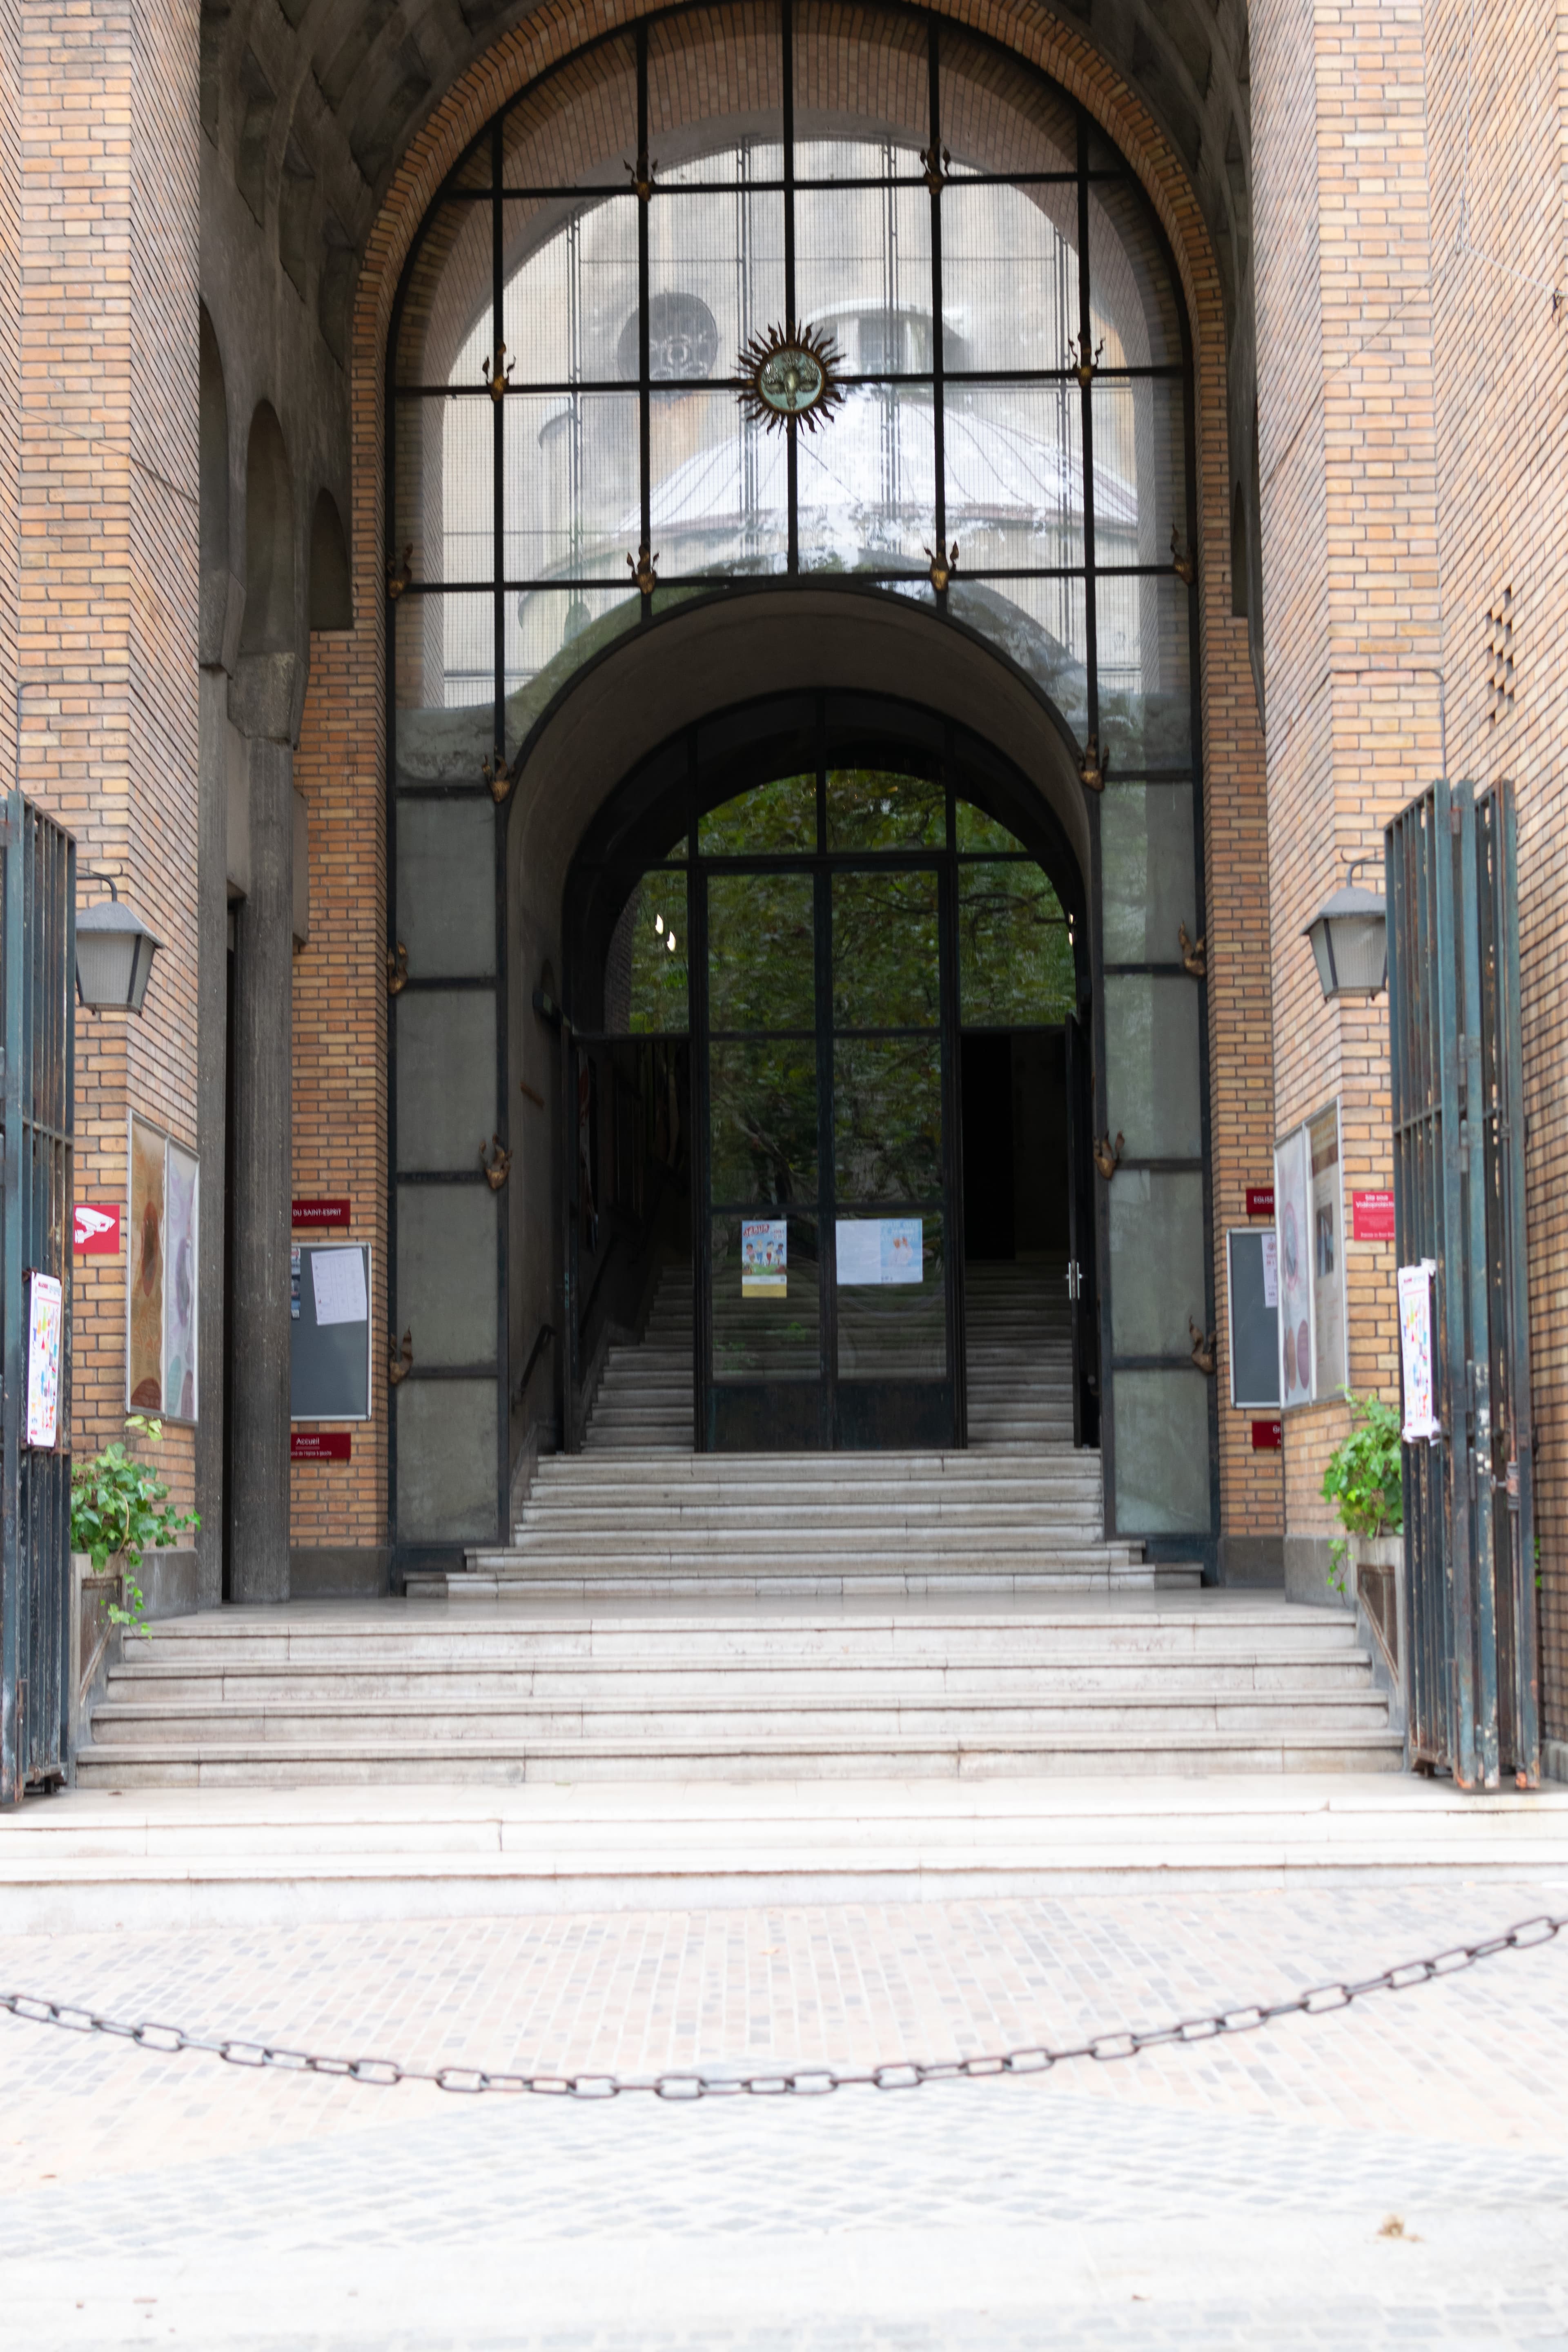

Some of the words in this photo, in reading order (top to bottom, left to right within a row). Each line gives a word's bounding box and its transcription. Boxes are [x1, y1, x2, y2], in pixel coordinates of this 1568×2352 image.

[293, 1208, 302, 1217] DU
[303, 1207, 341, 1217] SAINT-ESPRIT
[296, 1437, 320, 1446] Accueil
